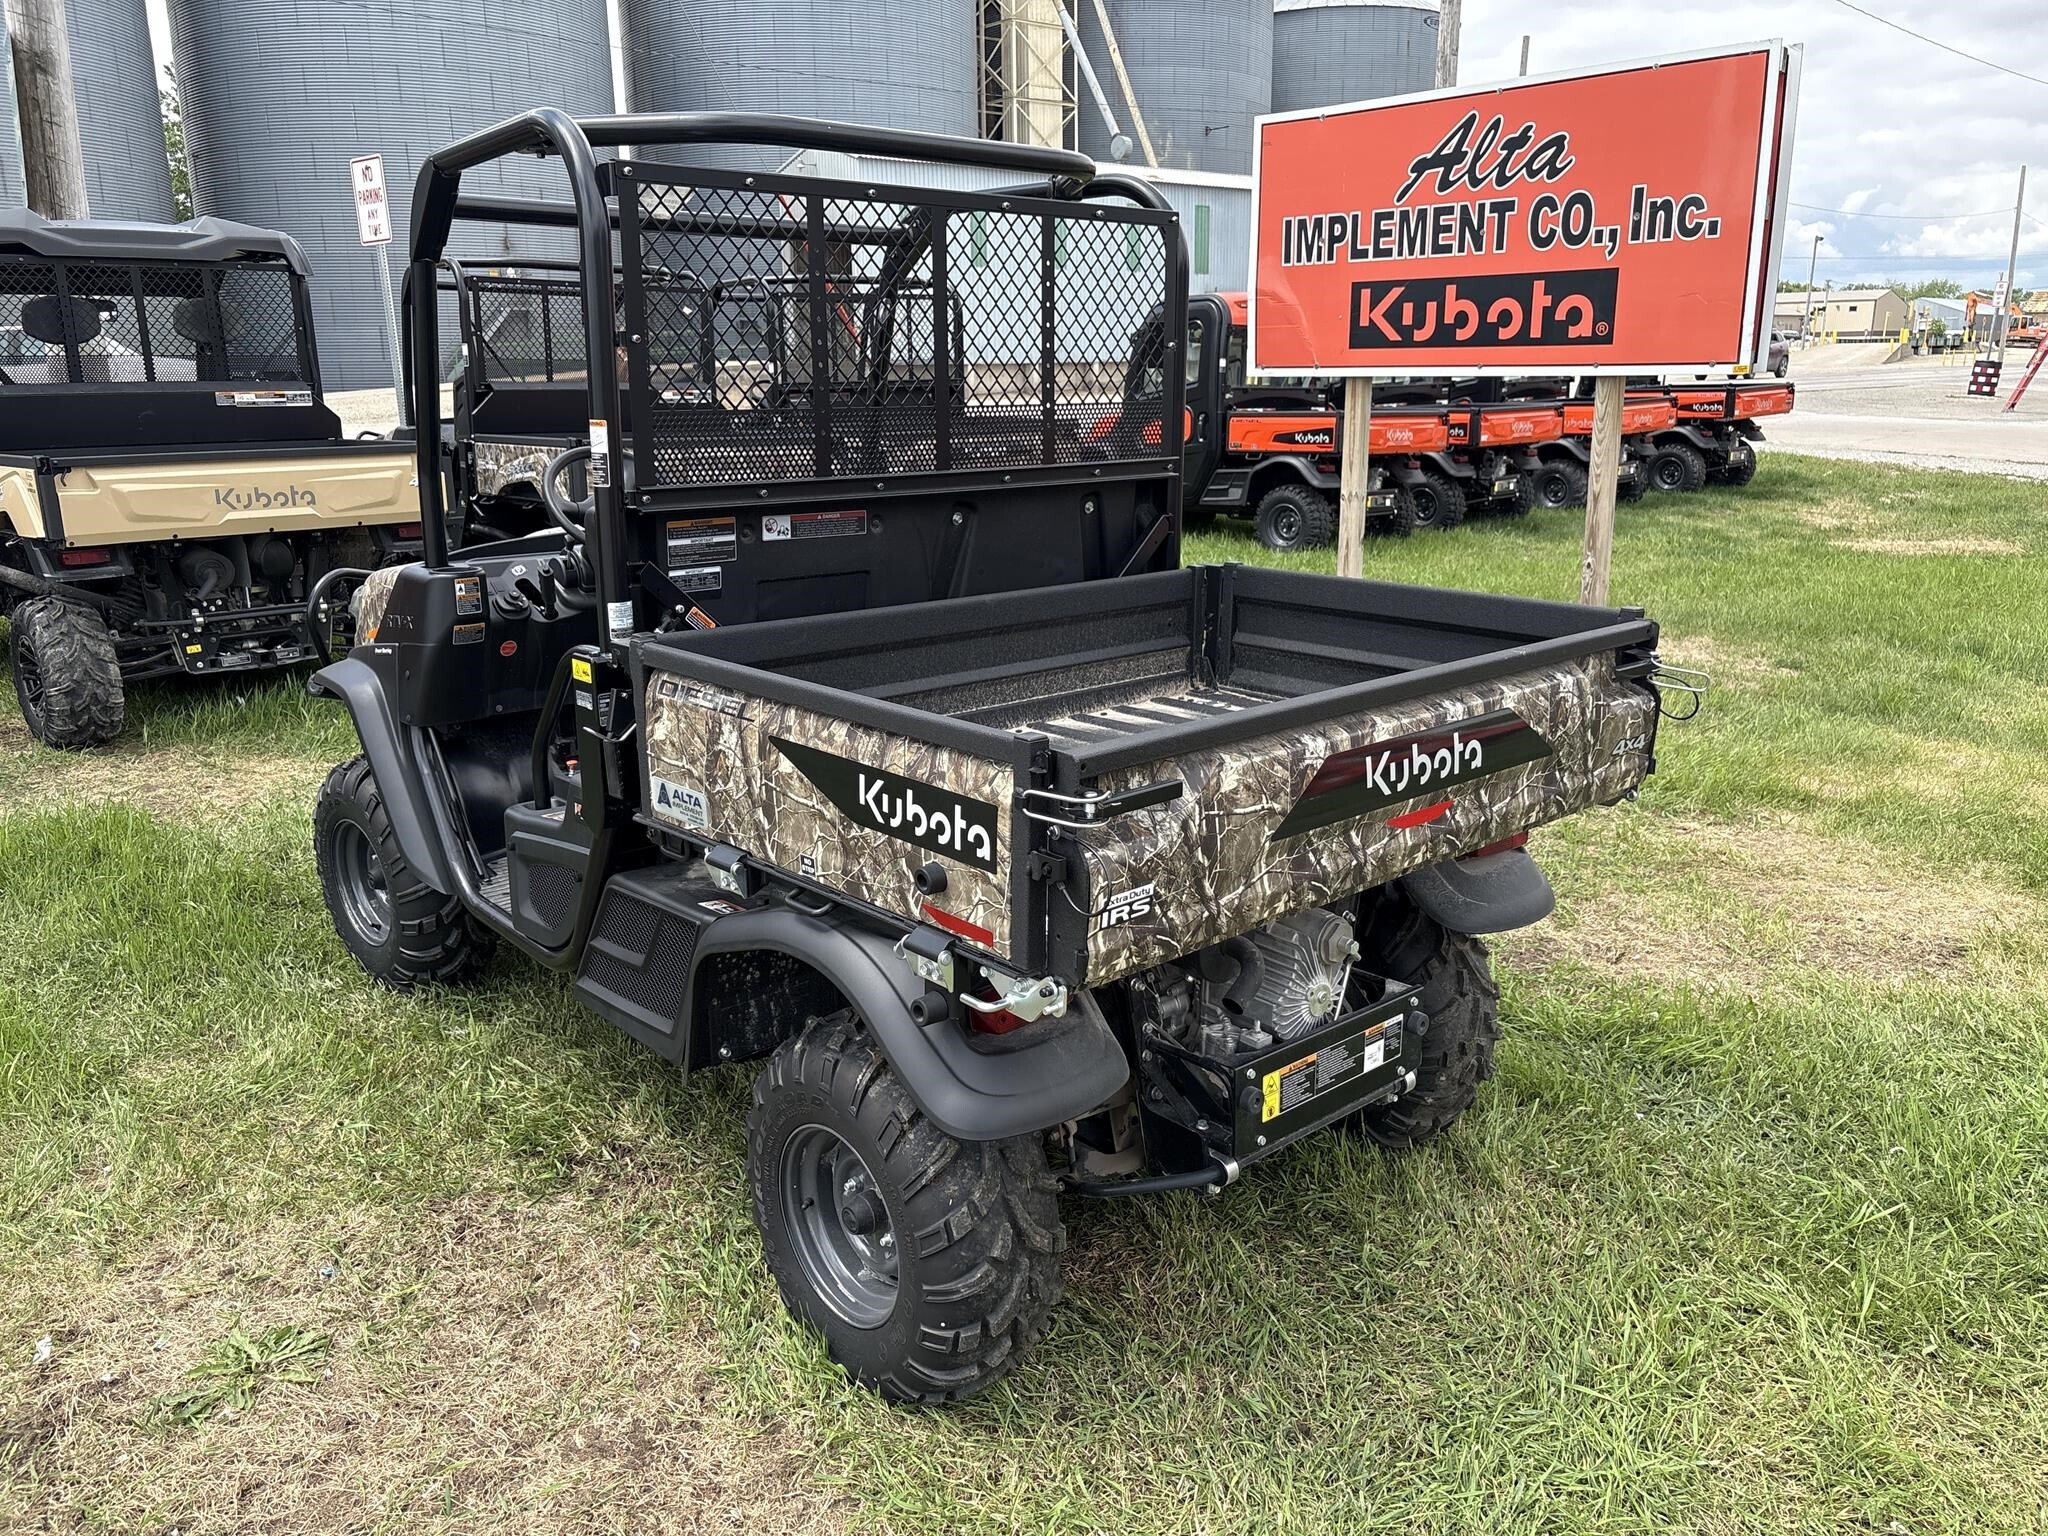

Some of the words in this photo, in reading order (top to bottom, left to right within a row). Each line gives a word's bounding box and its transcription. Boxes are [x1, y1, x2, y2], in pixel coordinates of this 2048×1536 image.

[1396, 110, 1576, 203] Alta
[362, 165, 373, 183] NO
[358, 187, 383, 206] PARKING
[368, 209, 378, 221] ANY
[1281, 197, 1518, 267] IMPLEMENT
[1528, 190, 1621, 260] CO.,
[1627, 183, 1722, 245] Inc.
[368, 224, 382, 236] TIME
[1358, 280, 1594, 342] Kubota
[1692, 403, 1723, 412] Kubota
[1564, 418, 1594, 428] ubota
[1294, 432, 1330, 444] Kubota
[215, 485, 317, 511] Kubota
[659, 679, 756, 722] DIESEL
[1611, 733, 1648, 757] 4x4
[1365, 732, 1483, 796] Kubota
[672, 789, 703, 810] ALTA
[858, 773, 991, 862] Kubota
[803, 857, 812, 866] NO
[1129, 887, 1151, 900] Duty
[1101, 897, 1151, 929] IRS
